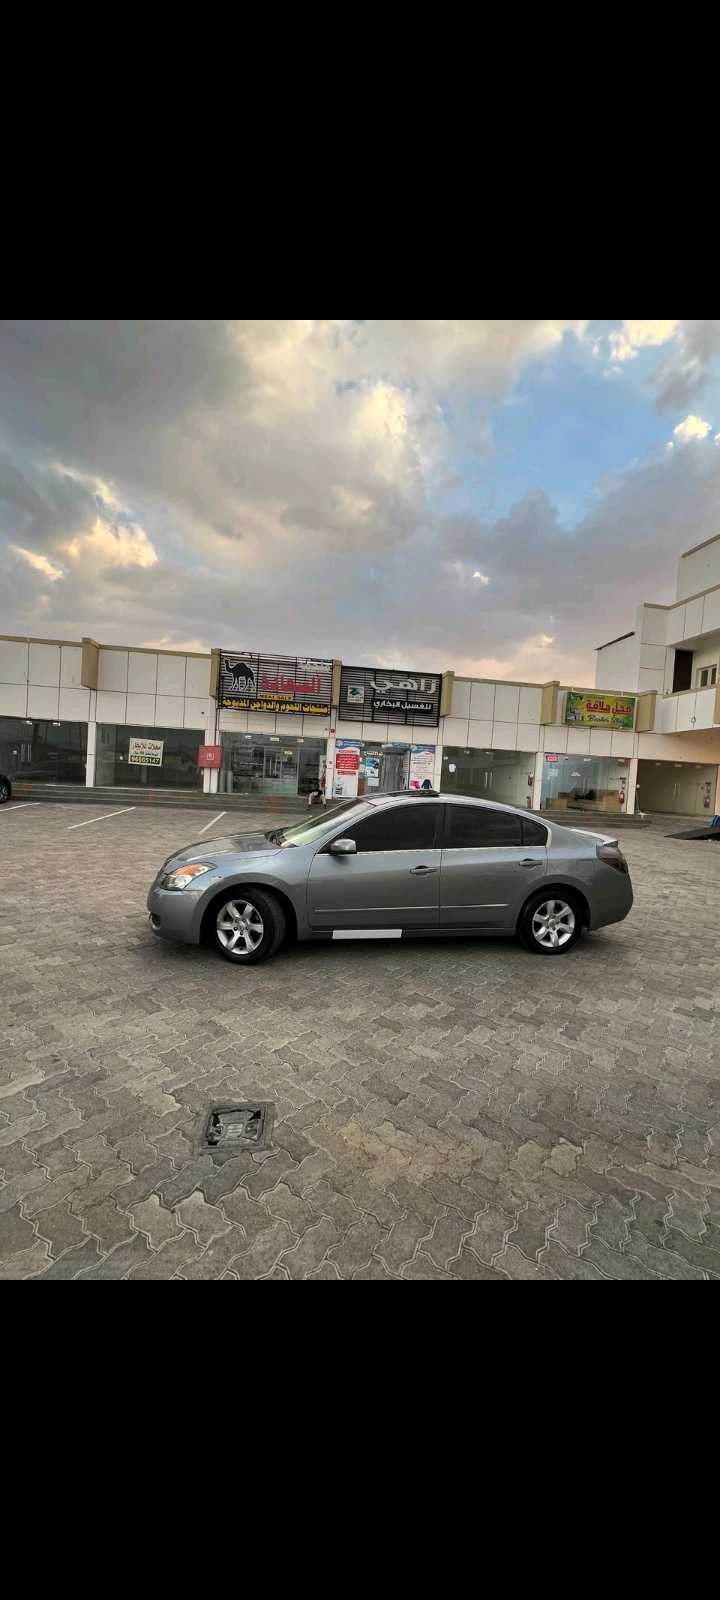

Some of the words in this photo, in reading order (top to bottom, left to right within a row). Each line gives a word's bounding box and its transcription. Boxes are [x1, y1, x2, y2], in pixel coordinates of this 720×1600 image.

[370, 679, 436, 694] زاهي
[373, 700, 401, 709] البخاري
[401, 702, 432, 710] للغسيل
